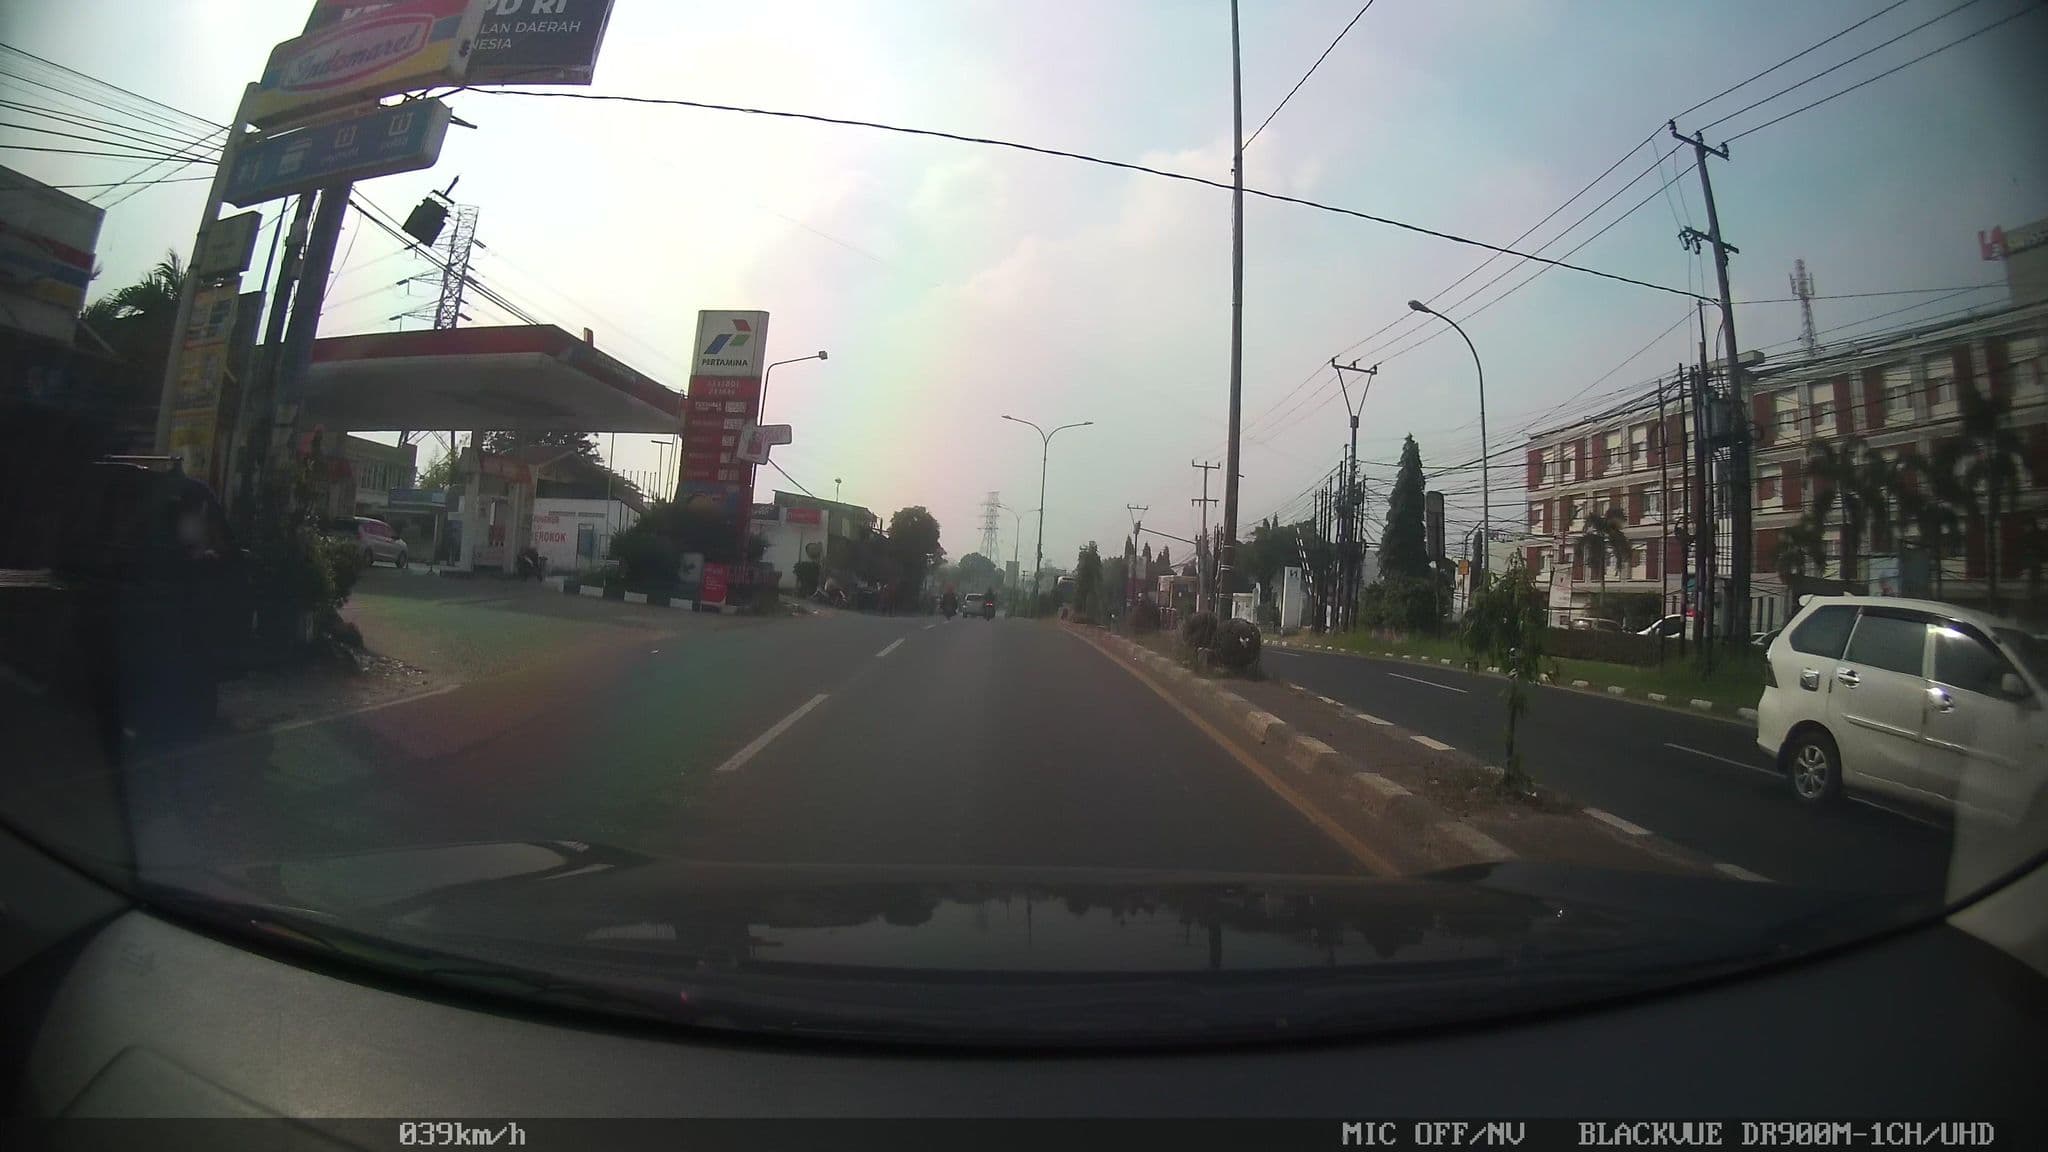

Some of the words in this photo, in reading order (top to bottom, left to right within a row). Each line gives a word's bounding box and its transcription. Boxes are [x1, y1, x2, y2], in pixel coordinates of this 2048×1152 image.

[531, 0, 568, 14] RI
[515, 20, 581, 33] DAERAH
[702, 358, 748, 367] PERTAMINA
